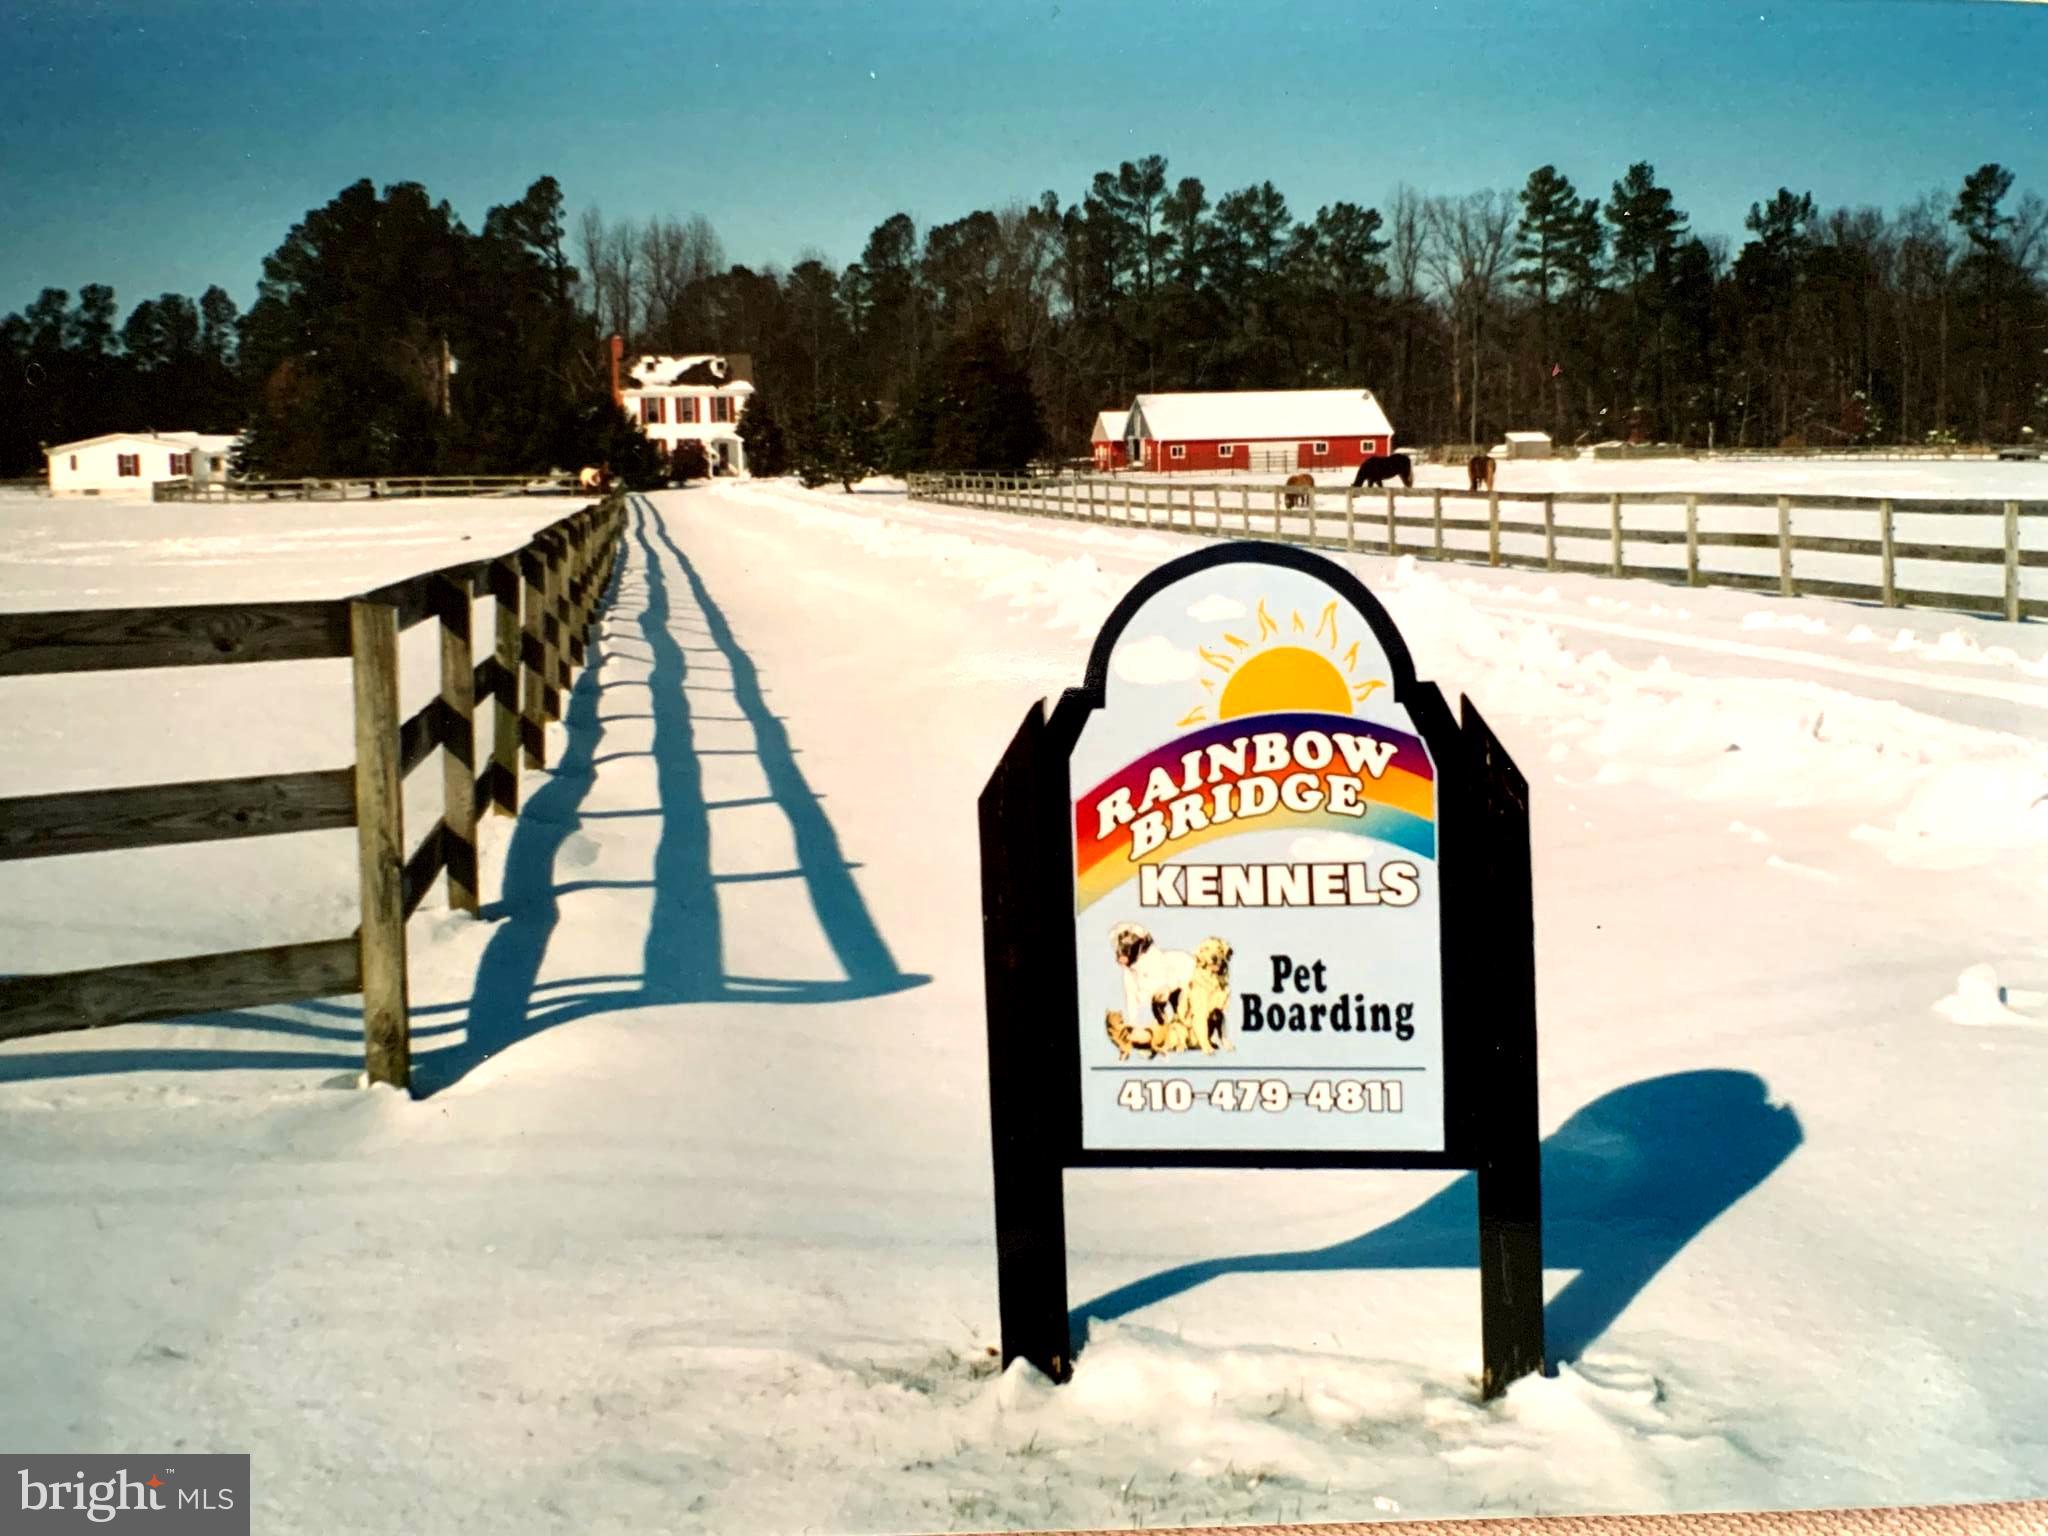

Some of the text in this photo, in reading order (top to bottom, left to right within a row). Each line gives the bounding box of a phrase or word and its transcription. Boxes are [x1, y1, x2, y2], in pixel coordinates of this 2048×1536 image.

[1096, 731, 1398, 840] RAINBOW
[1128, 773, 1366, 861] BRIDGE
[1139, 861, 1420, 907] KENNELS
[1270, 955, 1327, 993] Pet
[1241, 993, 1415, 1041] Boarding
[1117, 1079, 1403, 1113] 410-479-4811
